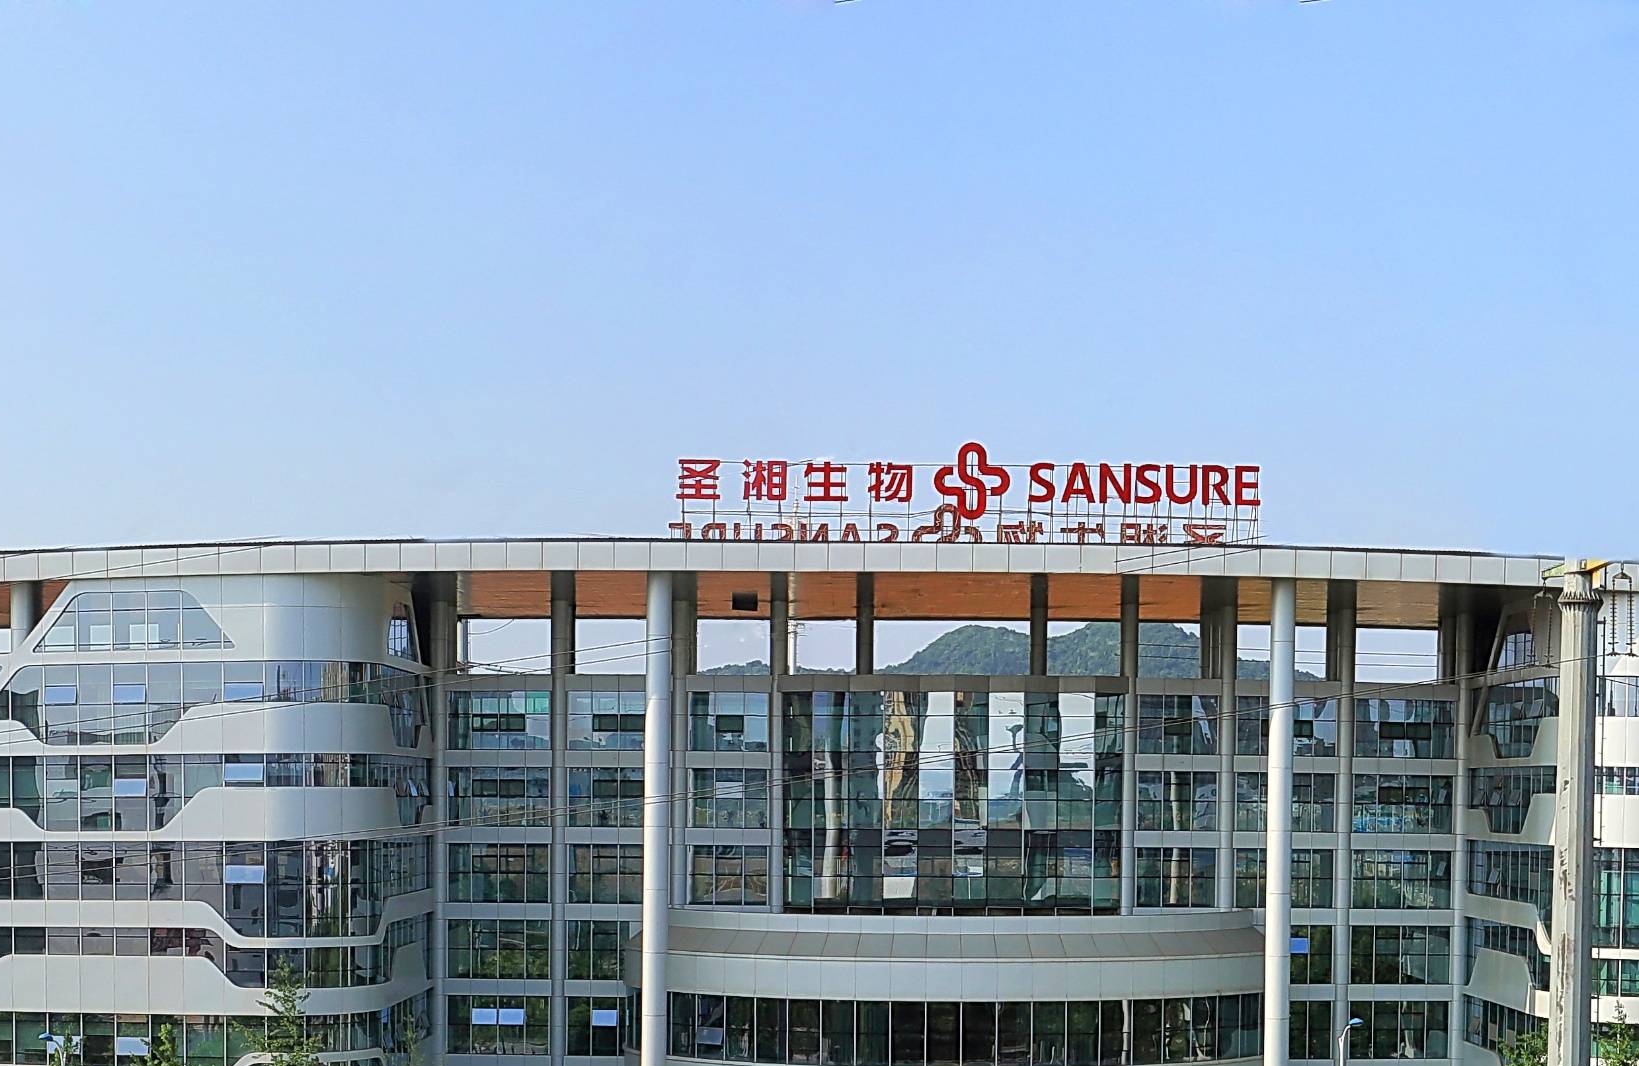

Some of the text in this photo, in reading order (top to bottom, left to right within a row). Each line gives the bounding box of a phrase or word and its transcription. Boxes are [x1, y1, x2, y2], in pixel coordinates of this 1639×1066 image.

[676, 459, 912, 502] 圣湘生物
[1029, 463, 1260, 506] SANSURE
